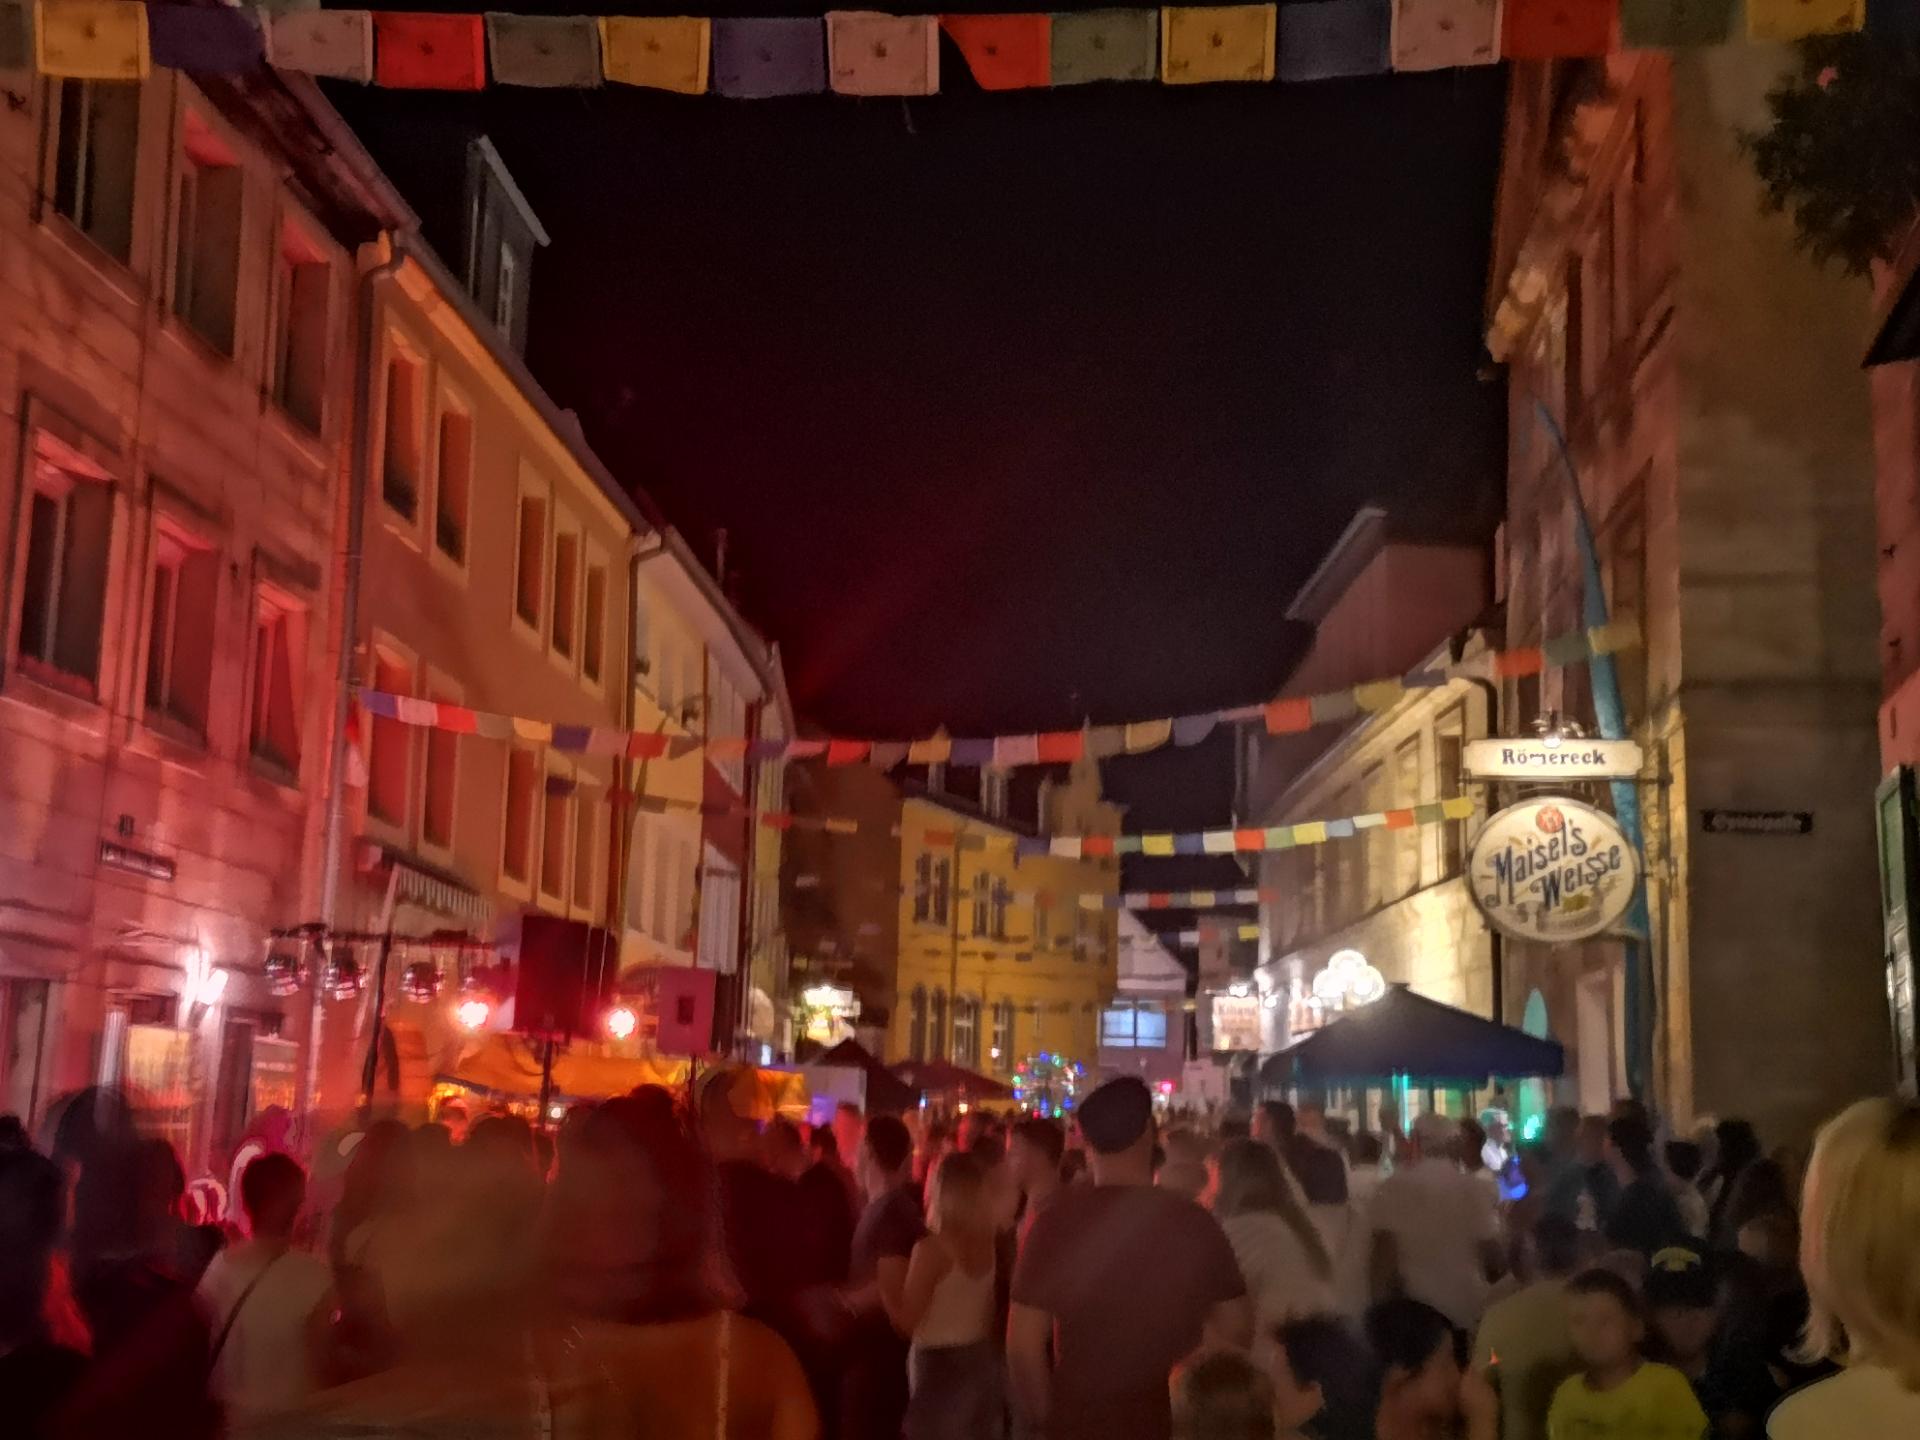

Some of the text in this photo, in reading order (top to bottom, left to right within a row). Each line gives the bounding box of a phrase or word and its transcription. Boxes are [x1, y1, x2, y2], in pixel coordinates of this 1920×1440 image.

[1502, 748, 1606, 765] Römereck
[1485, 818, 1587, 907] Maisel's
[1529, 845, 1621, 911] Weisse
